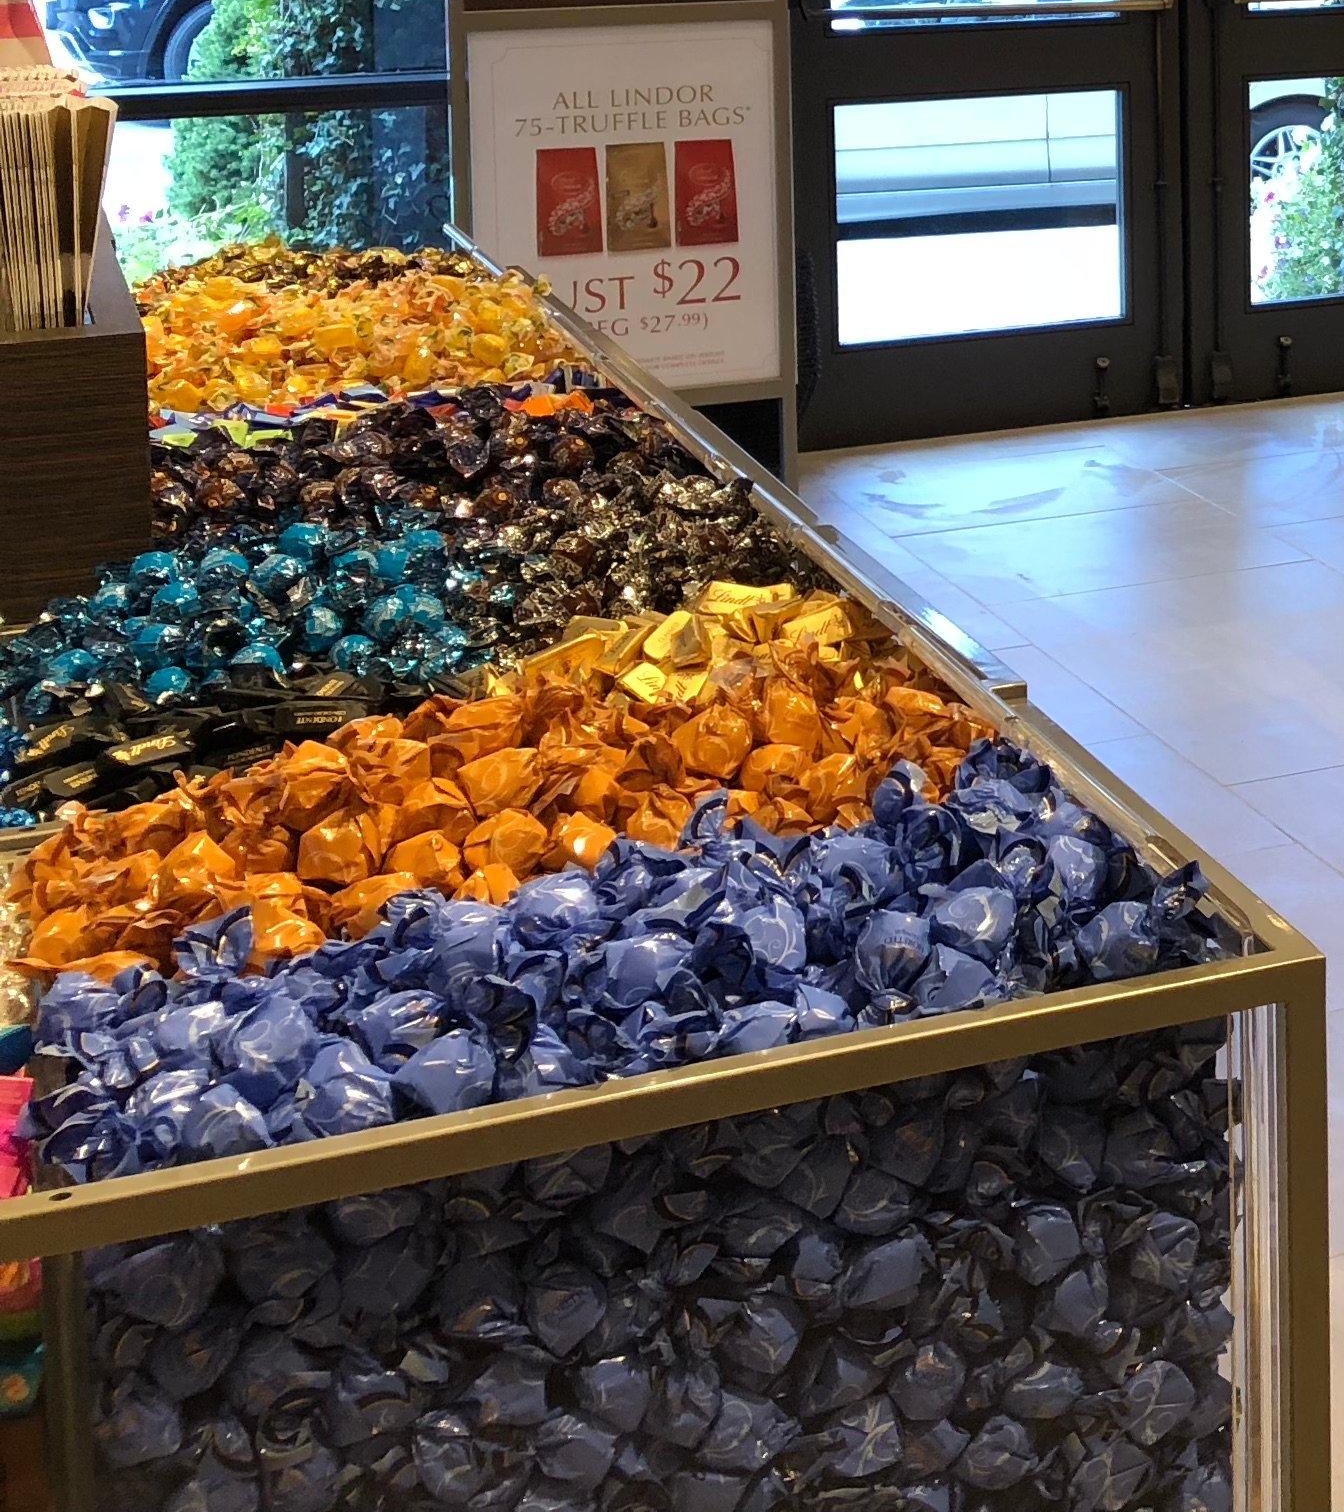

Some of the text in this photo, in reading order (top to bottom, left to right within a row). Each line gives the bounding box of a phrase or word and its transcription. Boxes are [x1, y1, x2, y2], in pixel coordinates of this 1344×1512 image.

[552, 84, 715, 110] ALL LINDOR
[514, 110, 668, 137] 75-TRUFFLE
[652, 256, 742, 306] $22
[639, 312, 709, 335] $27.99)
